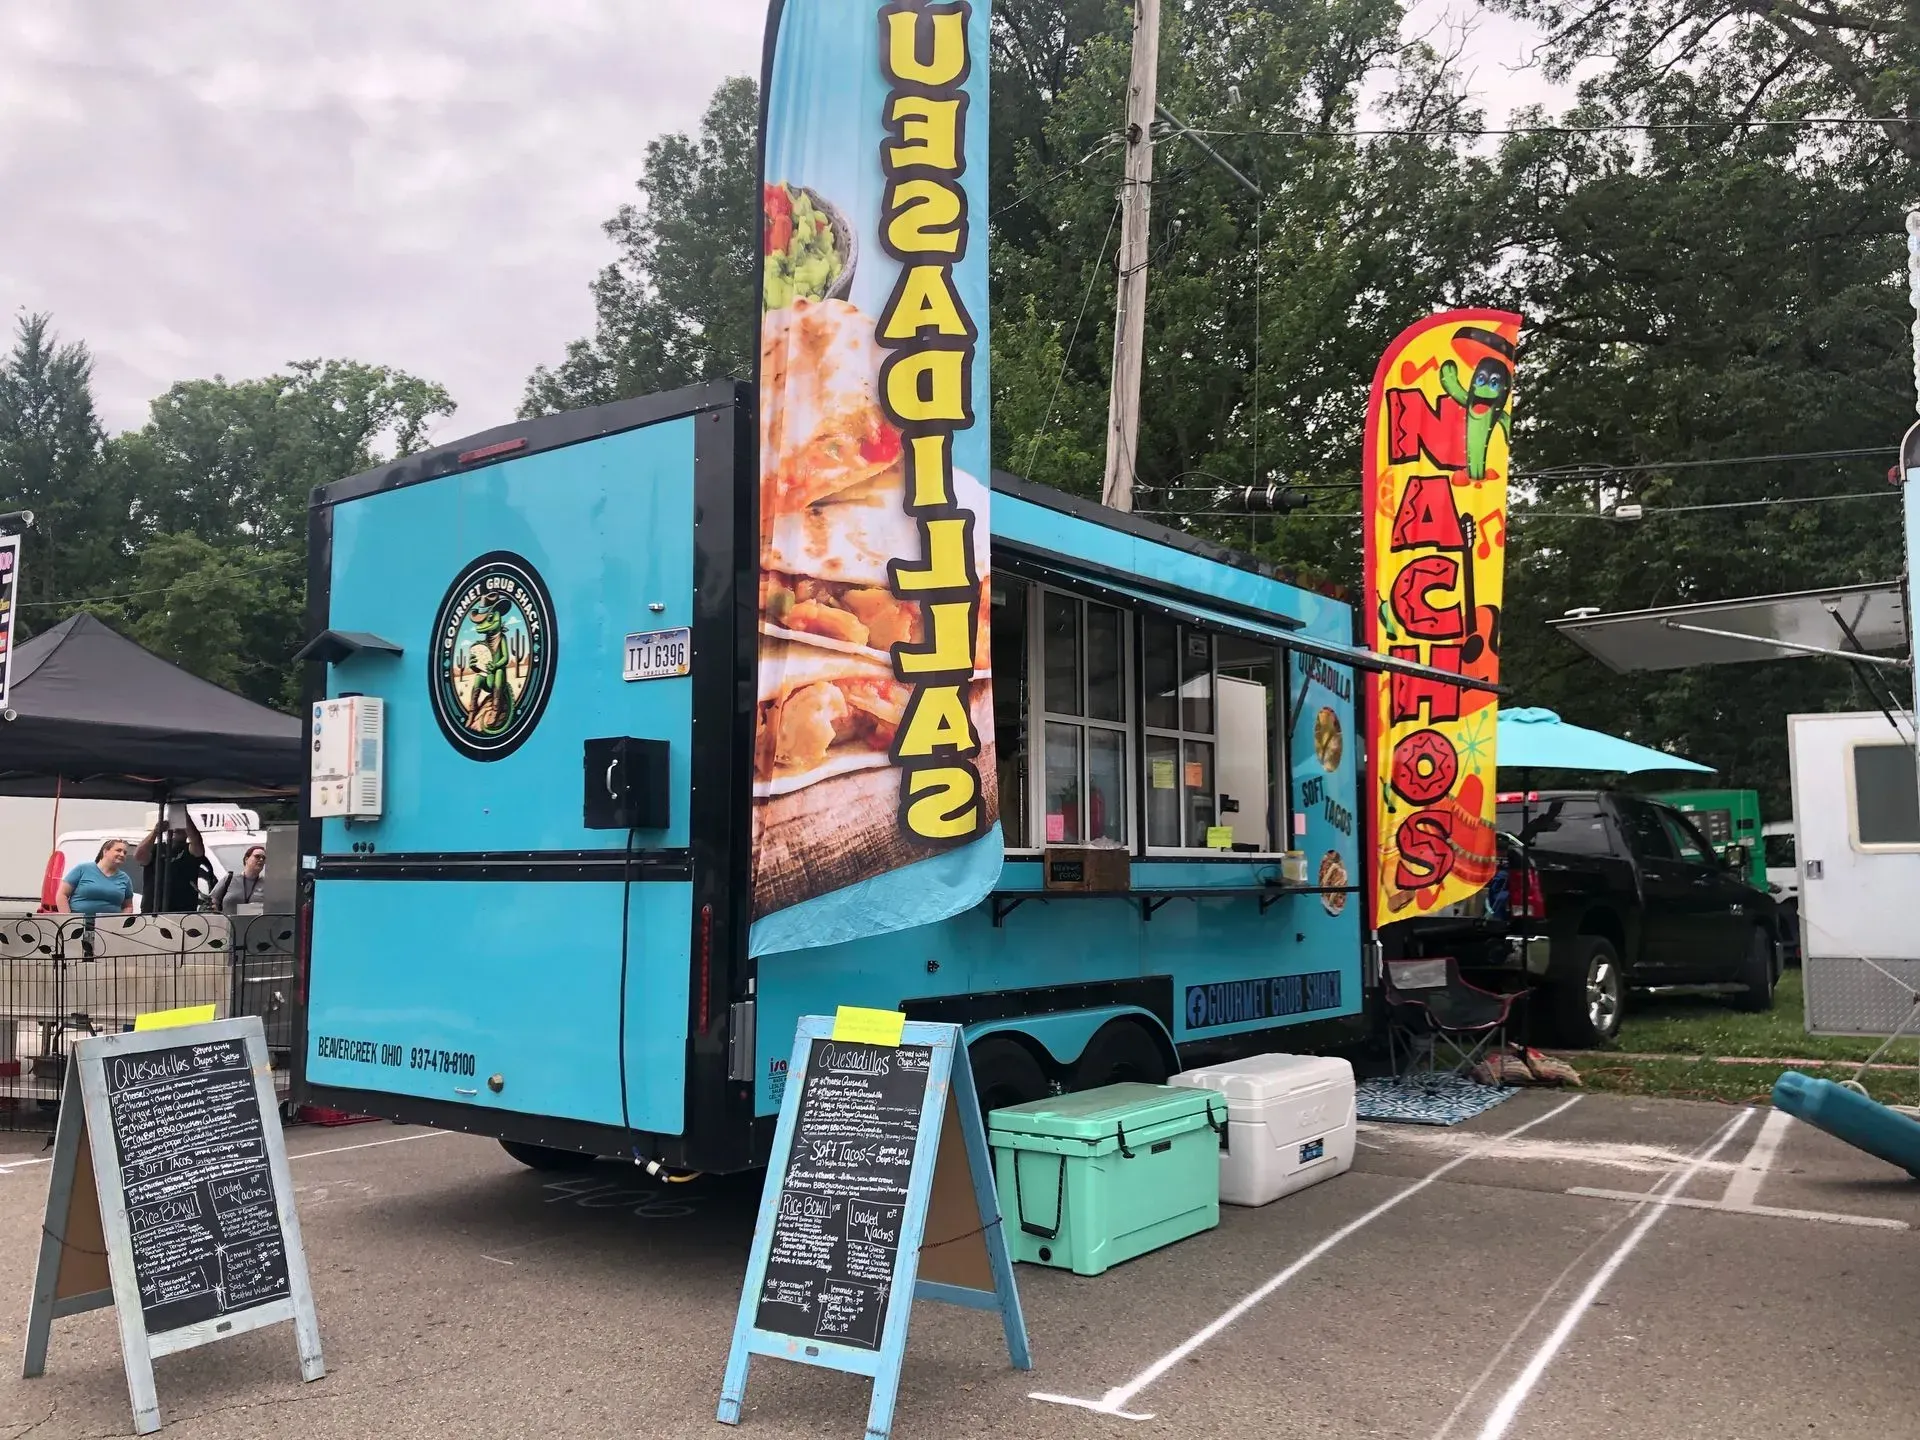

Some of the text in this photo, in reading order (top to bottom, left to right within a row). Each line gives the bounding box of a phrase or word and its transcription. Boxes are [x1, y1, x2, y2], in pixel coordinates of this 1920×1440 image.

[443, 577, 540, 648] GOURMET GRUB SHACK
[1385, 386, 1469, 893] NACHOS
[629, 643, 684, 671] TTJ 6396
[1302, 776, 1324, 808] SOFT
[1325, 795, 1352, 837] TACOS
[1207, 972, 1341, 1025] GOURMET GRUB SHACK
[318, 1036, 476, 1077] BEAVERCREEK OHIO 937-478-8100
[819, 1044, 888, 1074] Quesadillas
[114, 1055, 189, 1088] Quesadillas
[810, 1139, 865, 1162] Soft Tacos
[138, 1160, 163, 1177] SOFT
[166, 1154, 192, 1170] TACOS
[211, 1179, 243, 1198] Loaded
[230, 1188, 266, 1204] Nachos
[782, 1193, 801, 1213] Rice
[849, 1204, 878, 1229] Loaded
[864, 1225, 893, 1241] Nachos
